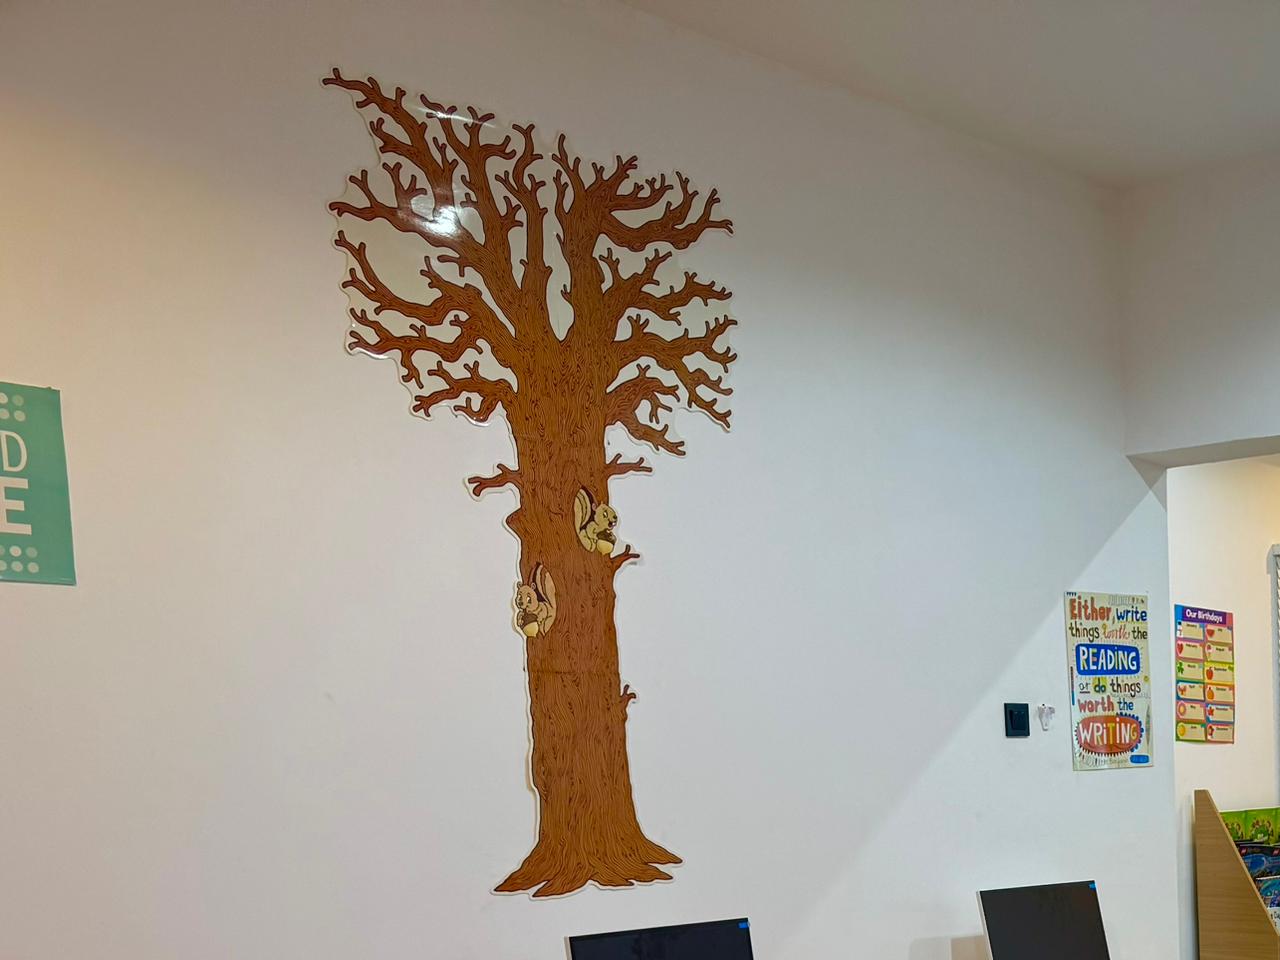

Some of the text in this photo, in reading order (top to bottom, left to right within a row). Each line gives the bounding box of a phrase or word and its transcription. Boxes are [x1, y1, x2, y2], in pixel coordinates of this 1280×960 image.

[1116, 606, 1147, 622] write
[1186, 609, 1223, 623] Our Birthdays
[1068, 621, 1100, 642] things
[1132, 627, 1148, 640] the
[1079, 677, 1142, 697] or do things
[1078, 695, 1134, 713] worth the
